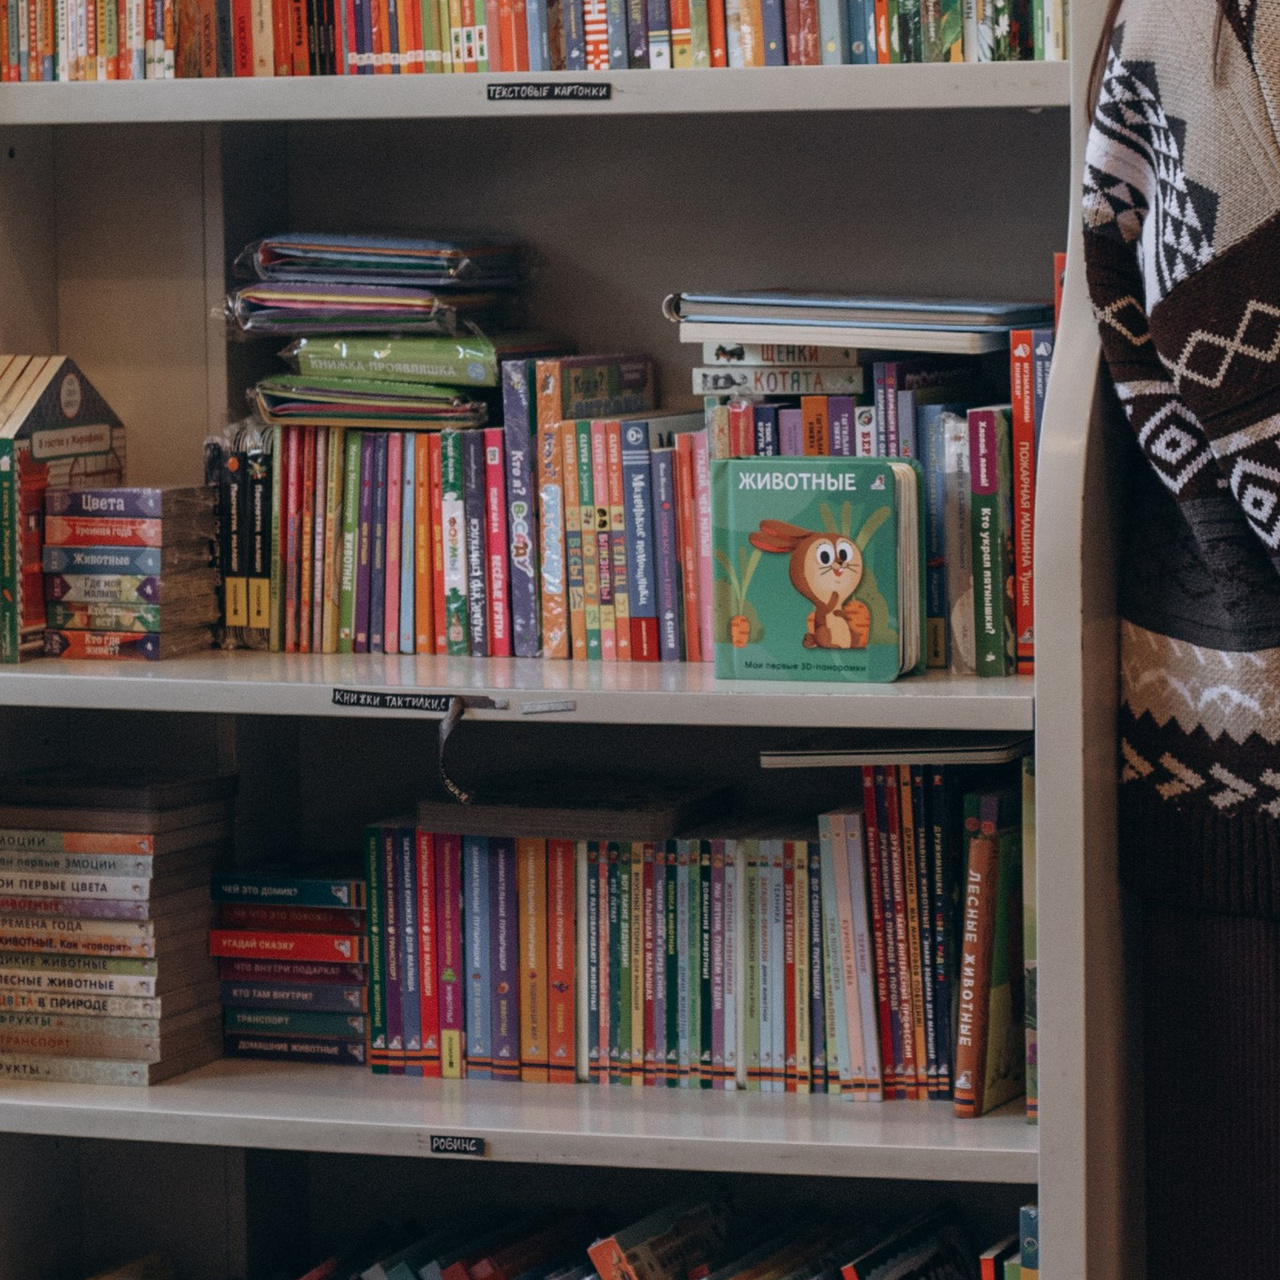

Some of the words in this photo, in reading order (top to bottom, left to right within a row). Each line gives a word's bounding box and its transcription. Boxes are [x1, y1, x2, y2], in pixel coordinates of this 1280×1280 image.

[488, 86, 550, 98] ТЕКСТОВЫЕ
[554, 85, 607, 96] КАРТОНКИ
[762, 344, 819, 363] ЩЕНКИ
[309, 360, 365, 371] КНИЖКА
[369, 361, 457, 376] ПРОЯВЛЯШКА
[754, 371, 824, 391] КОТЯТА
[512, 451, 525, 476] Кто
[739, 473, 857, 490] ЖИВОТНЫЕ
[1019, 441, 1031, 508] ПОЖАРНАЯ
[82, 495, 125, 511] Цвета
[981, 508, 991, 529] Кто
[981, 532, 992, 567] украл
[1020, 512, 1032, 567] МАШИНА
[73, 553, 130, 566] Животные
[342, 532, 354, 591] ЖИВОТНЫЕ
[569, 537, 582, 580] ВЕСЫ
[599, 534, 611, 600] БЛИЗНЕЦЫ
[613, 536, 627, 587] ТЕЛЕЦ
[1021, 571, 1031, 606] Тушик
[982, 570, 995, 635] пятнышки?
[334, 691, 380, 706] КНИЖКИ
[385, 695, 441, 711] ТАКТИЛКИ,
[65, 859, 116, 870] ЭМОЦИИ
[19, 881, 66, 892] ПЕРВЫЕ
[71, 882, 108, 894] ЦВЕТА
[965, 871, 981, 942] ЛЕСНЫЕ
[221, 938, 257, 949] УГАДАЙ
[259, 941, 296, 951] СКАЗКУ
[48, 977, 115, 990] ЖИВОТНЫЕ
[38, 998, 46, 1008] В
[51, 998, 108, 1012] ПРИРОДЕ
[959, 954, 976, 1046] ЖИВОТНЫЕ
[433, 1137, 477, 1151] РОБИНС
